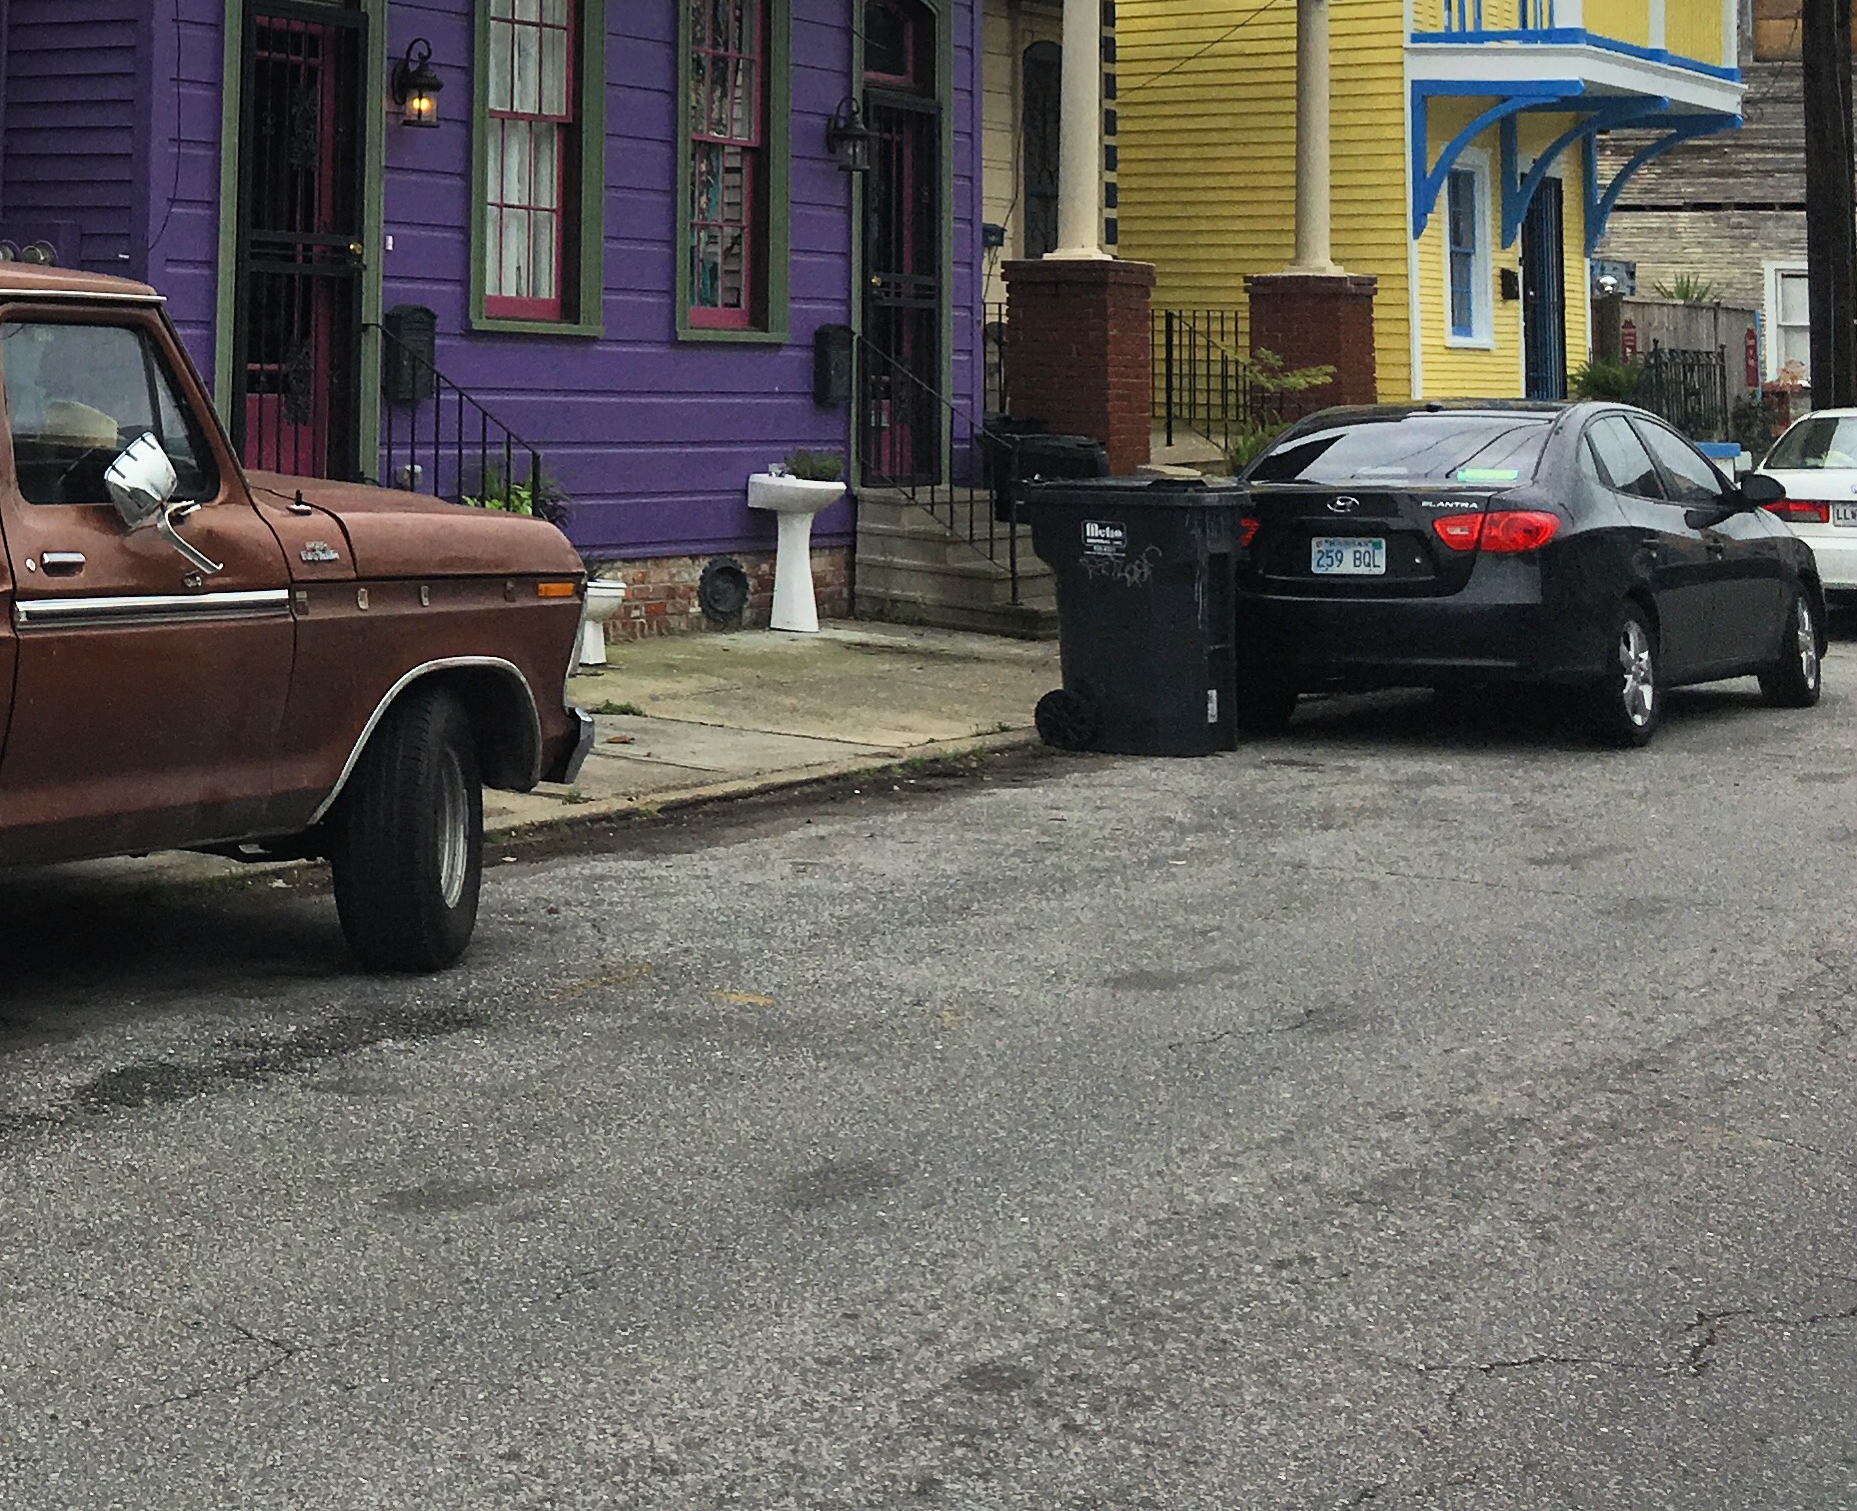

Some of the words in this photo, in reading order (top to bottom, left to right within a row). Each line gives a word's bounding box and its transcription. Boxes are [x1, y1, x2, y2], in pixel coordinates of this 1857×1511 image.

[1421, 500, 1479, 510] ELANTRA
[1316, 549, 1344, 568] 259
[1352, 549, 1381, 568] BQL
